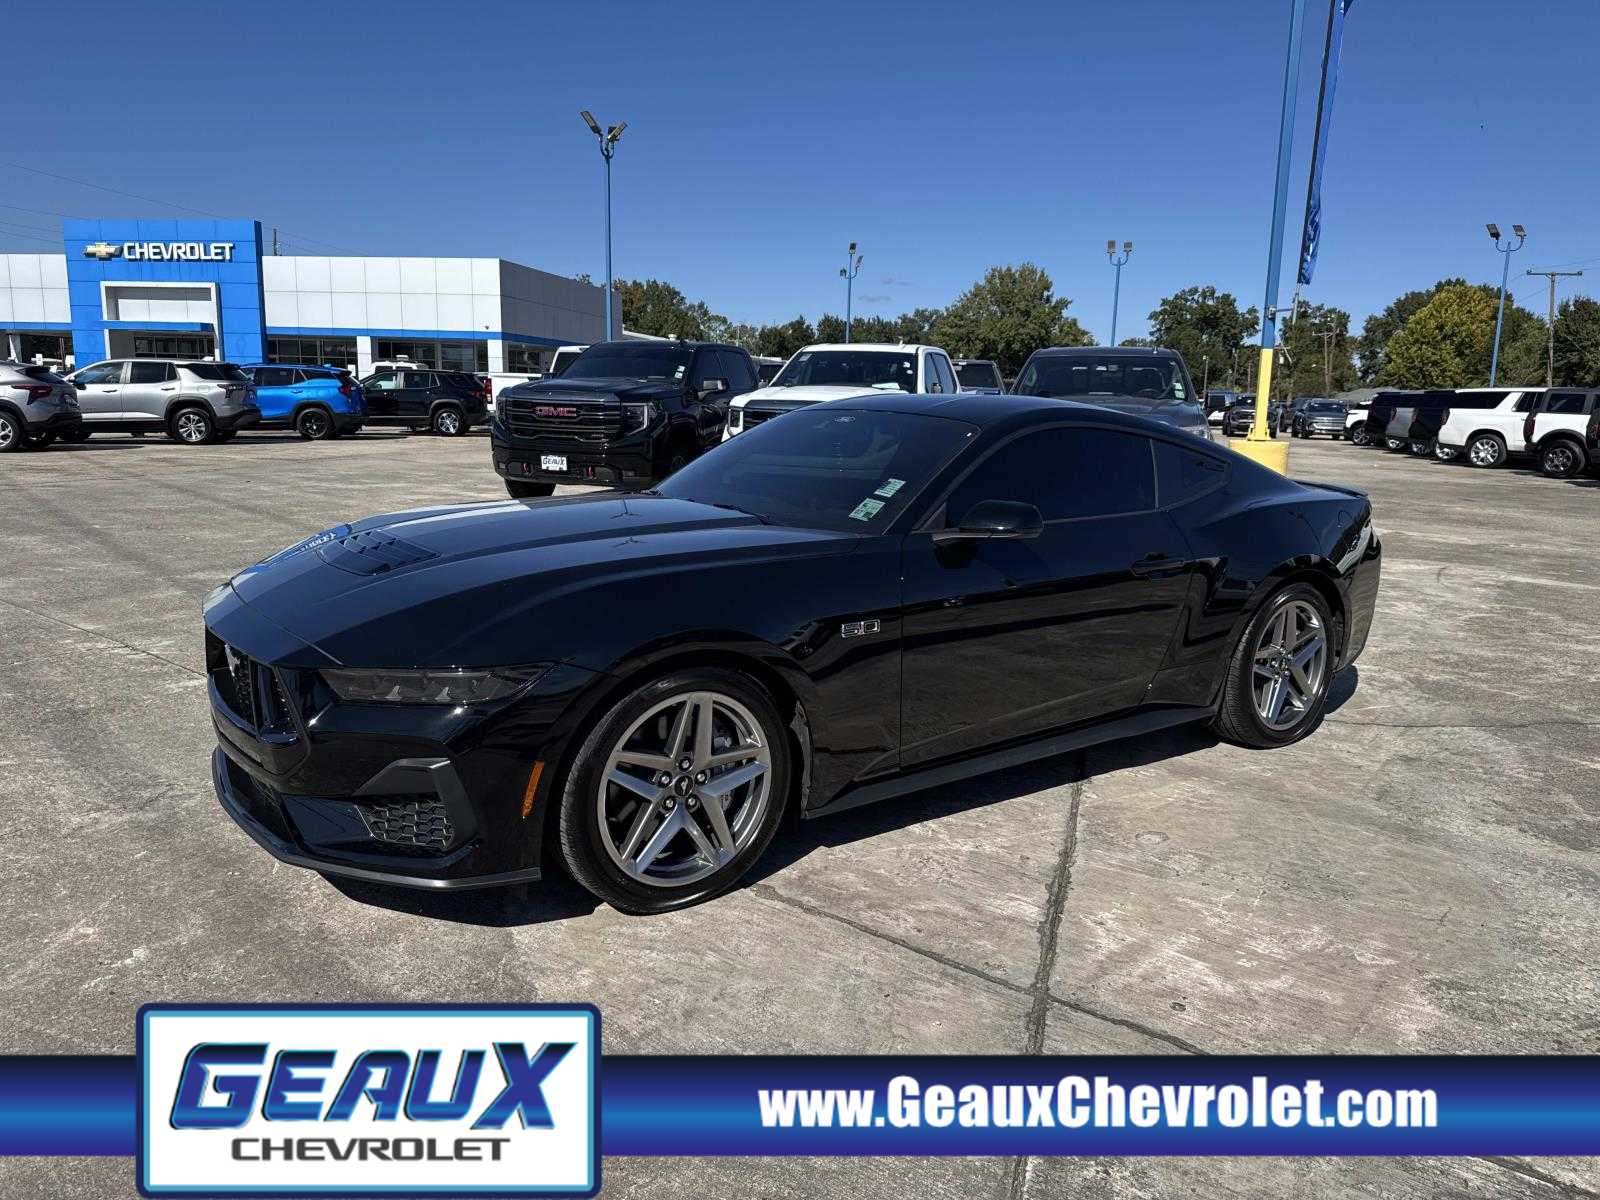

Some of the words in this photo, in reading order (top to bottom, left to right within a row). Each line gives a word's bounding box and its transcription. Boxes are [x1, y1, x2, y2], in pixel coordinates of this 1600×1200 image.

[123, 242, 233, 260] CHEVROLET
[535, 407, 577, 417] GMC
[543, 457, 566, 466] GEAUX
[841, 619, 881, 638] 5.0
